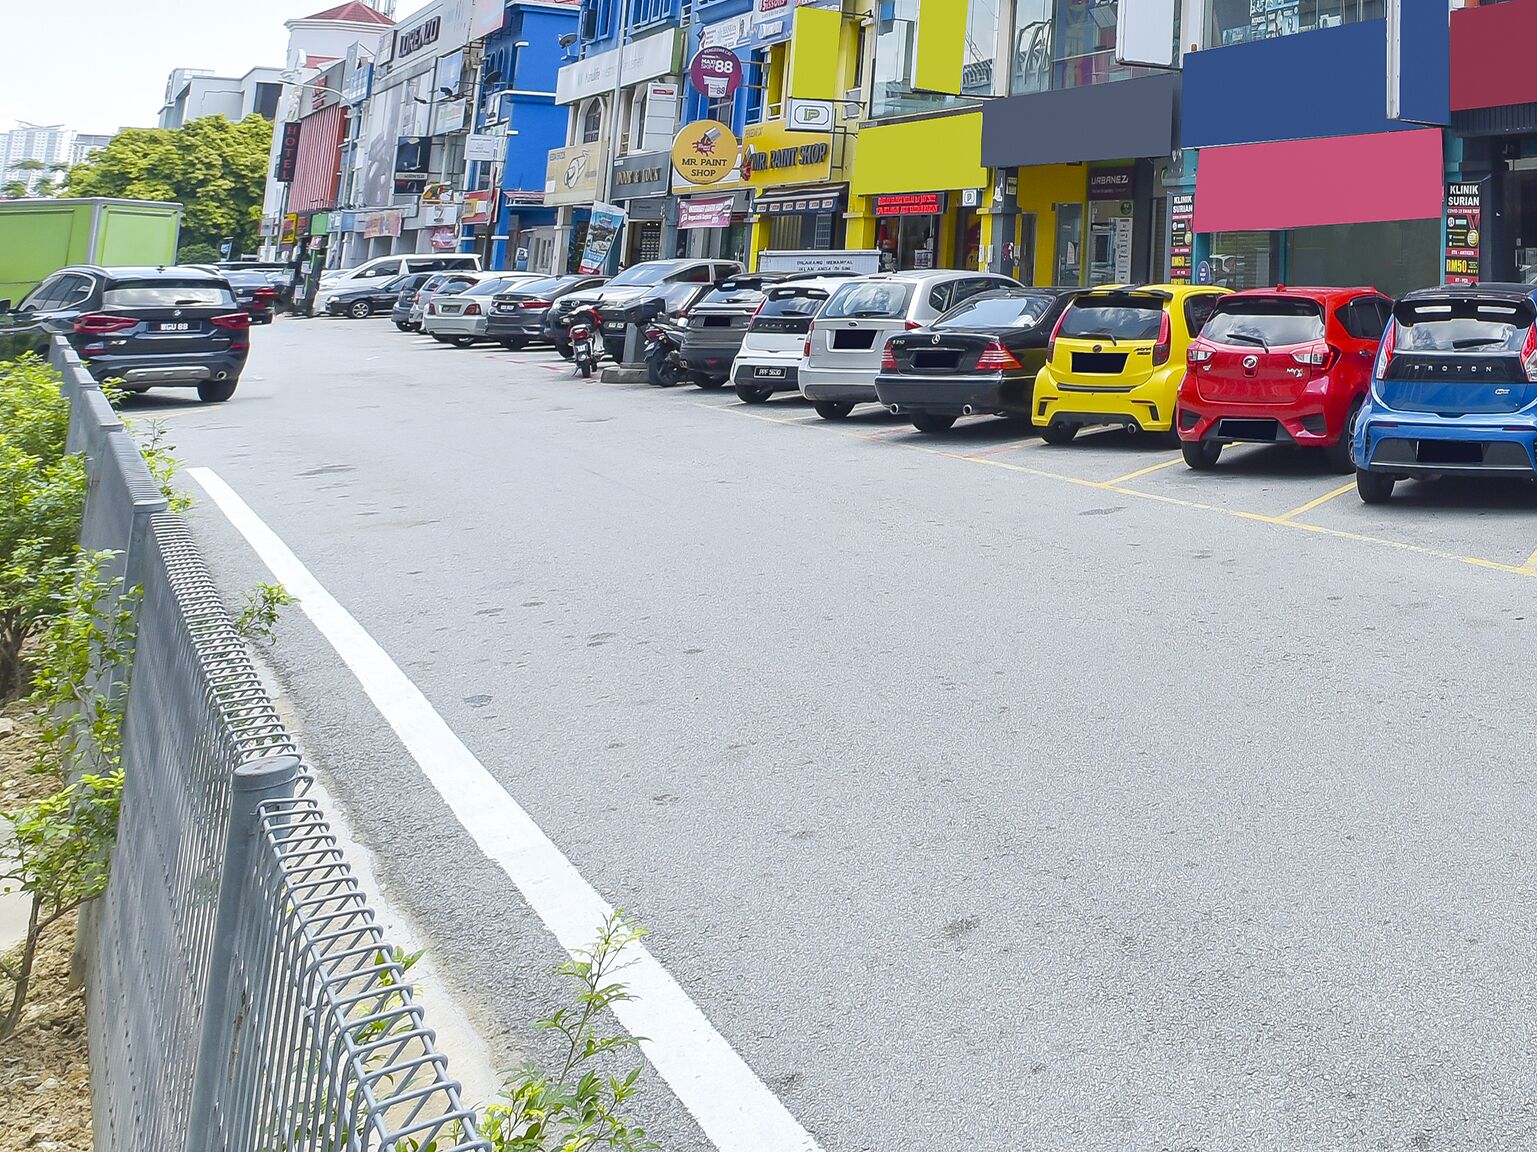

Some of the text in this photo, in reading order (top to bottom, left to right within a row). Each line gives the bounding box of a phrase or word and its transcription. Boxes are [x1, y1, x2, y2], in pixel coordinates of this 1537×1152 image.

[399, 16, 440, 58] LORENZO
[715, 60, 733, 73] 88
[281, 125, 298, 180] HOTEL
[769, 147, 798, 169] PAINT
[799, 142, 827, 165] SHOP
[682, 158, 728, 167] MR. PAINT
[691, 169, 716, 177] SHOP
[1449, 185, 1478, 195] KLINIK
[1174, 195, 1192, 204] KLINIK
[1448, 196, 1479, 206] SURIAN
[1172, 204, 1193, 213] SURIAN
[1446, 259, 1467, 273] RM50
[1414, 365, 1492, 373] PROTON
